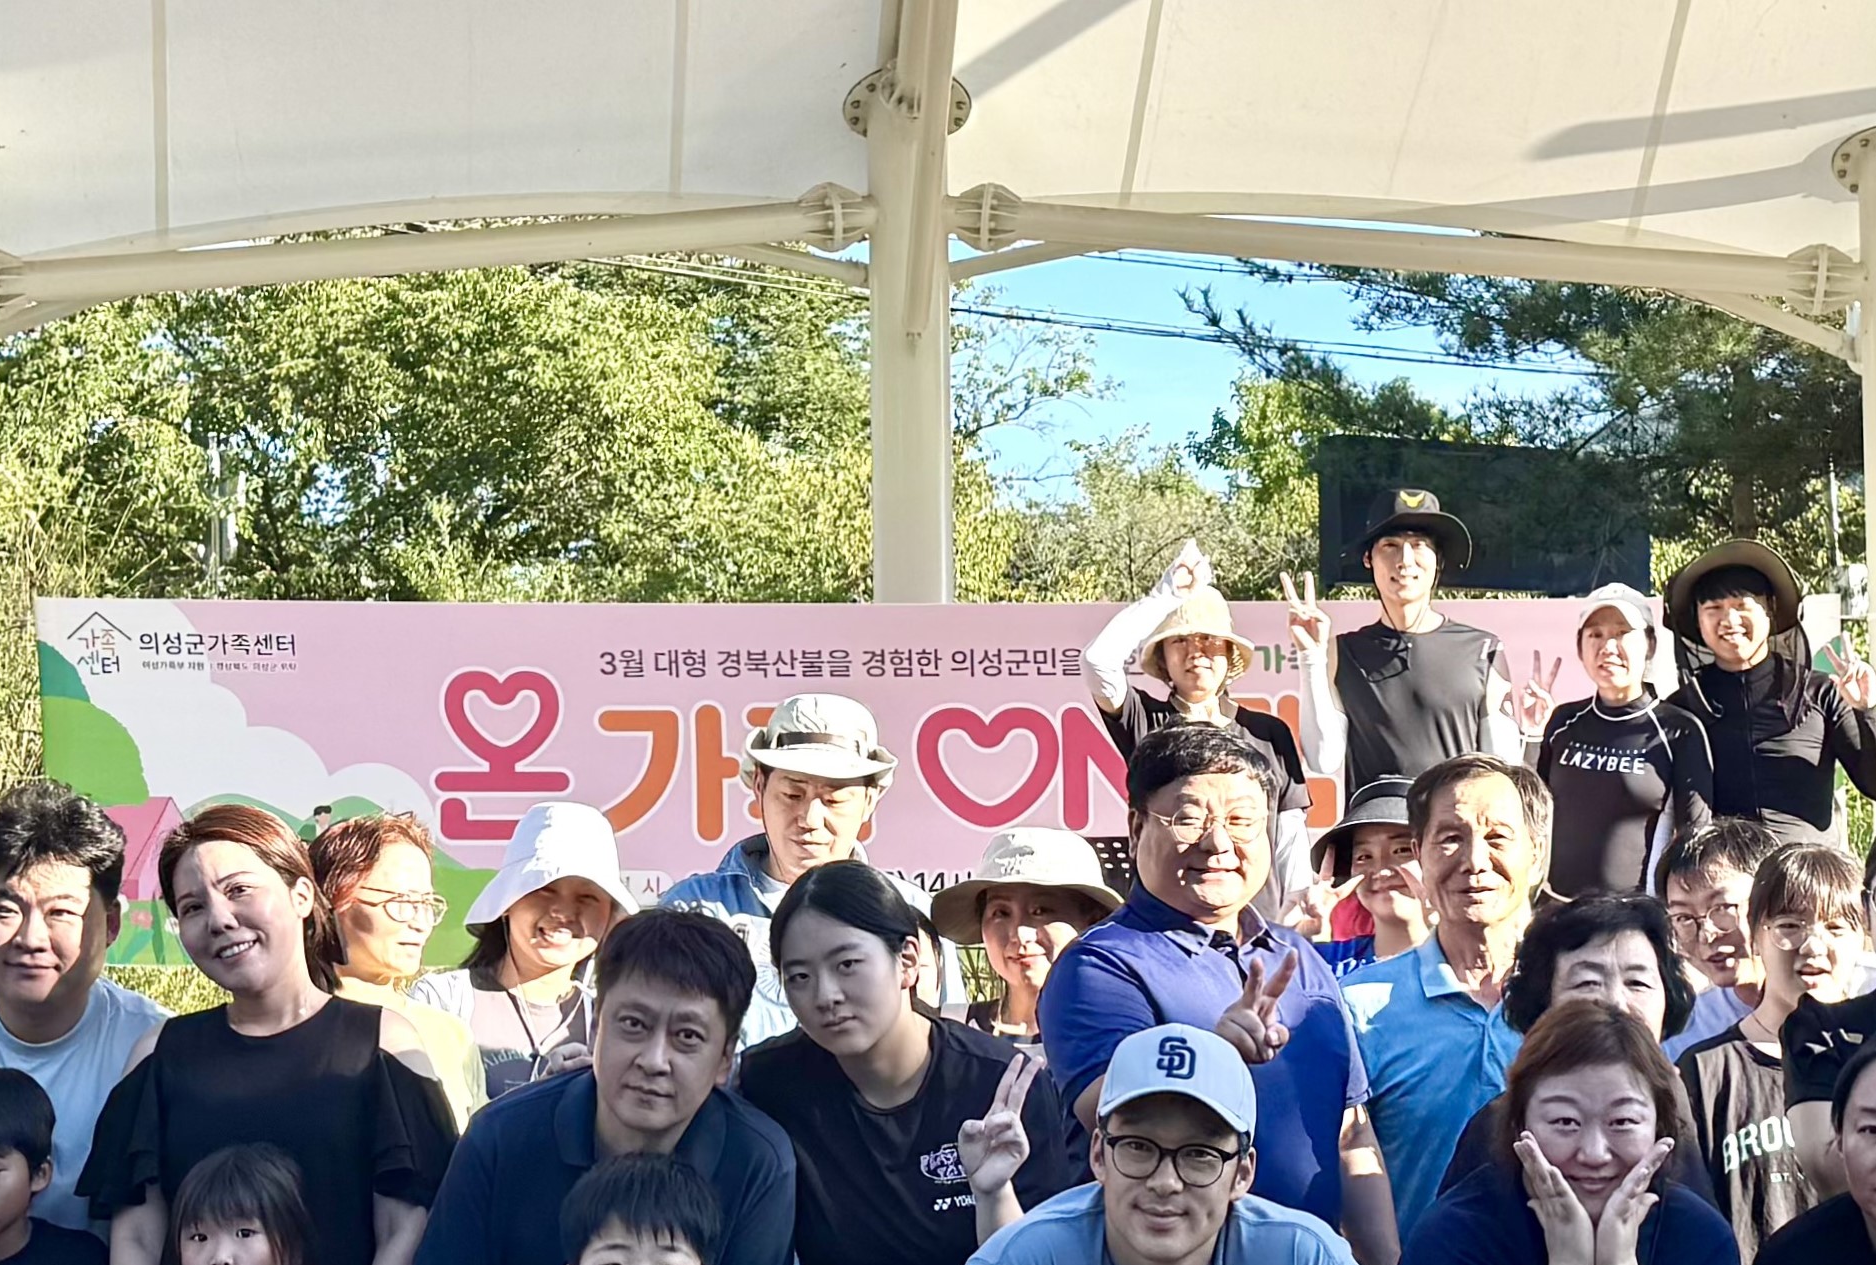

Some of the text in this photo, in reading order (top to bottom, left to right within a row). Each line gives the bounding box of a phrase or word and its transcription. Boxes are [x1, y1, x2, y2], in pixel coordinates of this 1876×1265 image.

[77, 628, 116, 656] 가족
[139, 631, 297, 656] 의성군가족센터
[77, 650, 120, 675] 센터
[598, 647, 1082, 678] 3월 대형 경북산불을 경험한 의성군민을
[434, 670, 570, 841] 온
[1558, 748, 1646, 775] LAZYBEE
